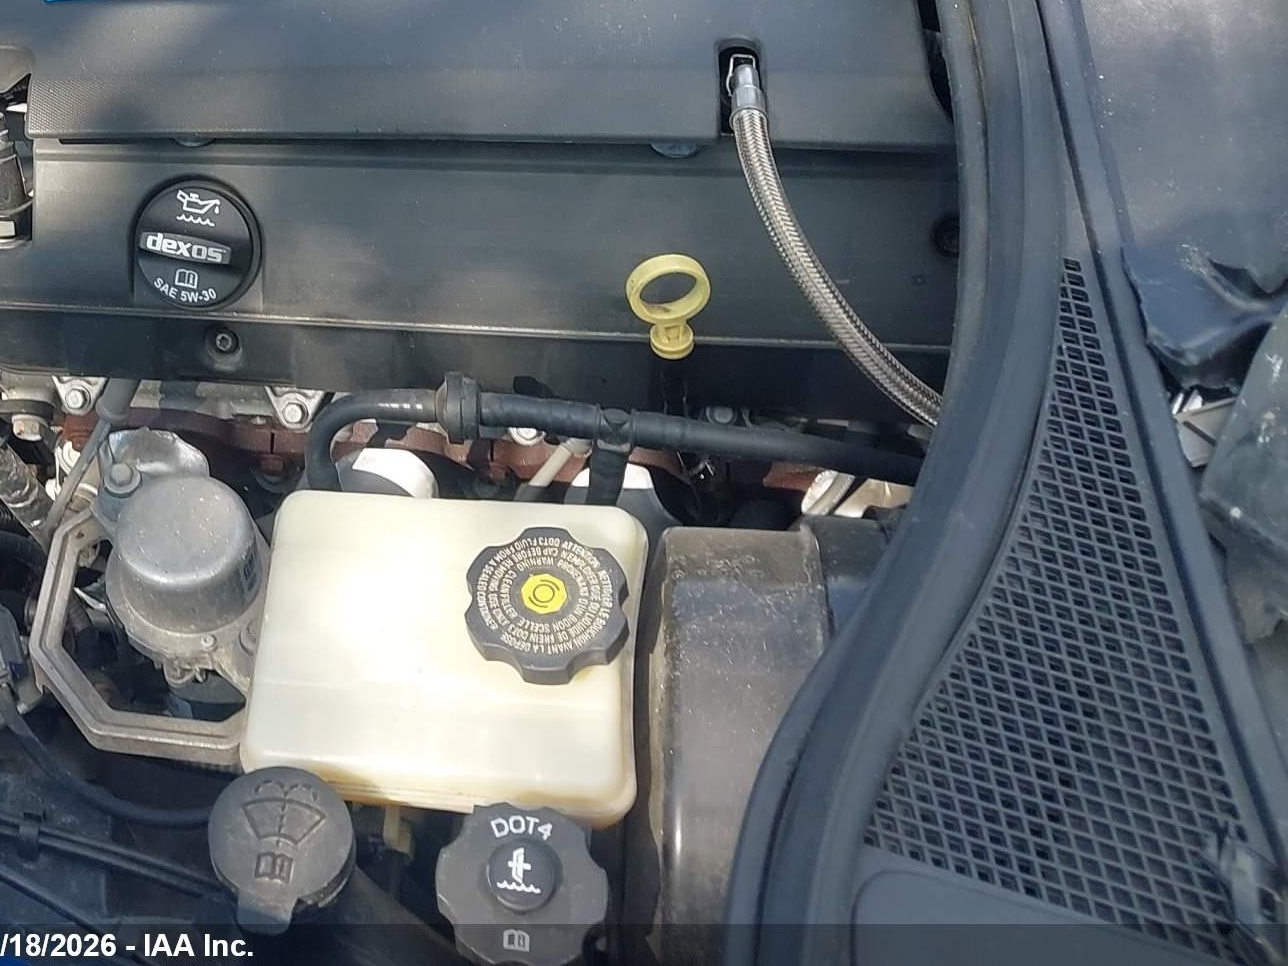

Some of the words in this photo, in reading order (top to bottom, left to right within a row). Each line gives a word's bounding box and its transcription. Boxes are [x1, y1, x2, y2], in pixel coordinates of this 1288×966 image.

[146, 232, 223, 263] dexos
[153, 277, 179, 299] SAE
[180, 288, 217, 304] 5W-30
[515, 538, 537, 550] FLUID
[538, 538, 560, 546] DOT3
[493, 547, 515, 561] FROM
[513, 547, 541, 561] BEFORE
[543, 547, 558, 556] CAP
[477, 565, 494, 590] SEALED
[488, 594, 499, 608] USE
[588, 601, 600, 613] DU
[599, 608, 610, 619] LE
[553, 615, 577, 632] BIDON
[571, 612, 594, 637] LIQUIDE
[508, 624, 528, 640] DOT3
[529, 634, 555, 644] FREIN
[557, 632, 569, 642] DE
[574, 619, 606, 648] BOUCHON
[533, 645, 544, 653] LA
[548, 641, 574, 654] AVANT
[491, 815, 552, 841] DOT4
